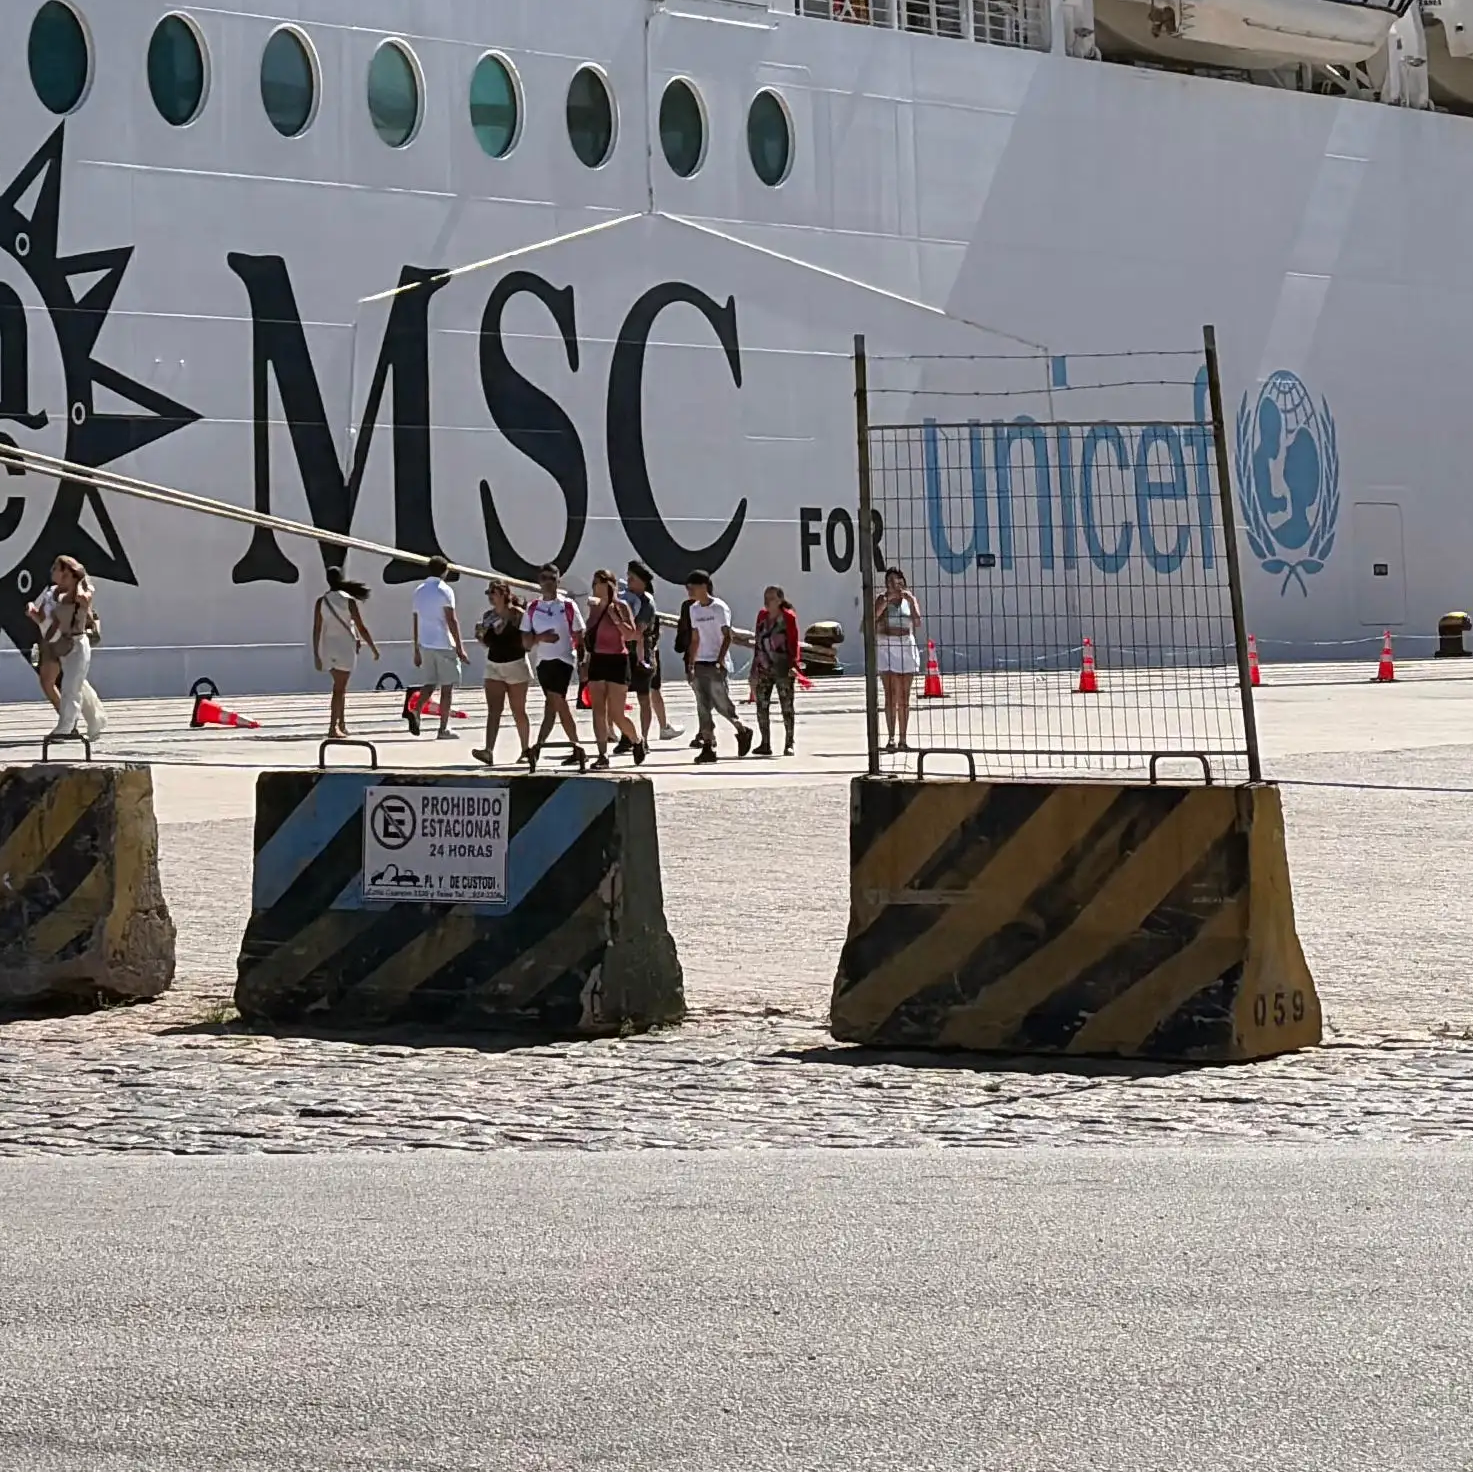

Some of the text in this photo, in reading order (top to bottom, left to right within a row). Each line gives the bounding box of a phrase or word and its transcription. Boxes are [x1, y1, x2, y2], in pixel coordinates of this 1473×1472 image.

[227, 251, 749, 587] MSC
[922, 355, 1215, 575] unicef
[421, 796, 502, 817] PROHIBIDO
[421, 818, 501, 839] ESTACIONAR
[429, 843, 493, 858] 24 HORAS
